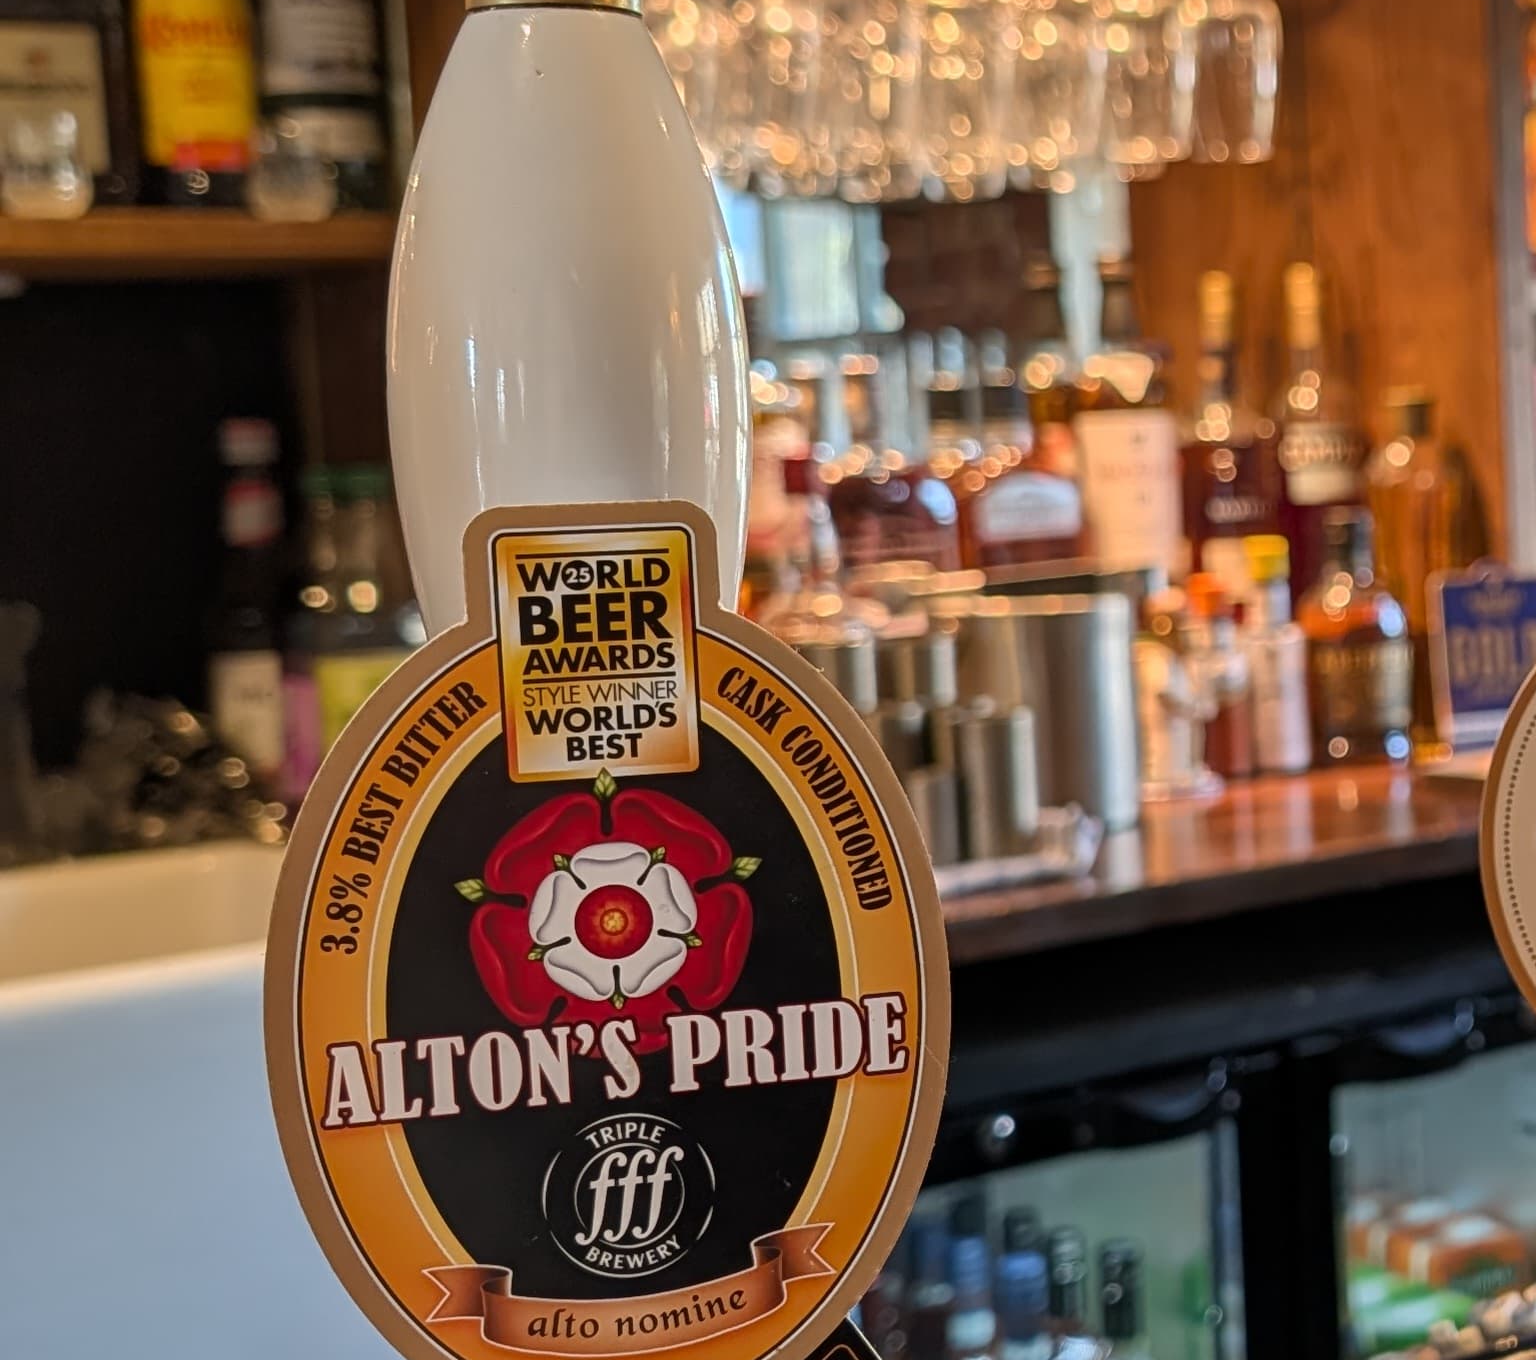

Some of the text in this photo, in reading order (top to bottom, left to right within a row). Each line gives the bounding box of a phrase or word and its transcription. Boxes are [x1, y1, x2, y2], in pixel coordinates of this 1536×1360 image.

[518, 591, 674, 646] BEER
[523, 642, 676, 676] AWARDS
[523, 680, 679, 707] STYLE WINNER
[525, 702, 678, 736] WORLD'S
[566, 732, 643, 762] BEST
[717, 666, 893, 911] CASK CONDITIONED
[320, 681, 487, 955] 3.8% BEST BITTER
[322, 994, 908, 1129] ALTON'S PRIDE
[585, 1121, 666, 1149] TRIPLE
[574, 1145, 685, 1246] fff
[585, 1234, 681, 1270] BREWERY
[527, 1288, 747, 1339] alto nomine
